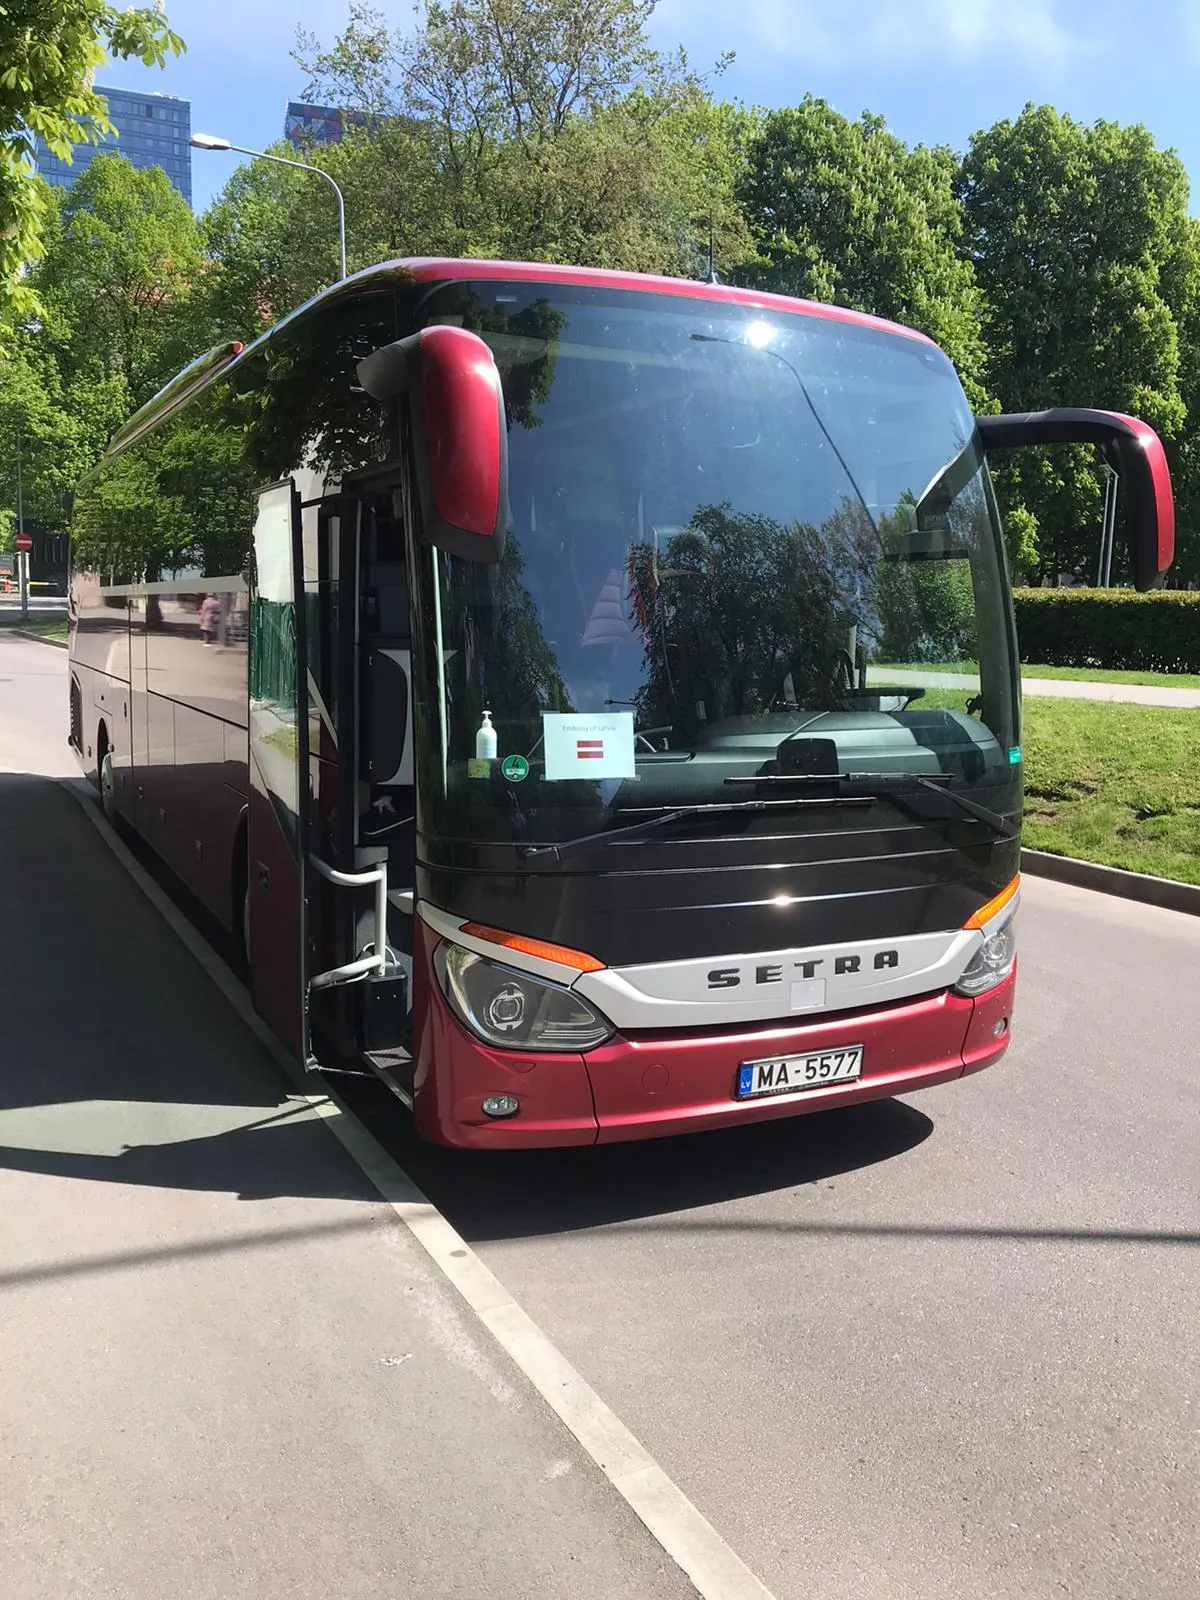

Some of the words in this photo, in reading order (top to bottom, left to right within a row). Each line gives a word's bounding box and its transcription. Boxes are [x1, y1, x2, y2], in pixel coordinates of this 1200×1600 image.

[512, 756, 520, 769] 4
[707, 950, 899, 990] SETRA
[757, 1051, 859, 1089] MA-5577
[741, 1081, 751, 1089] LV
